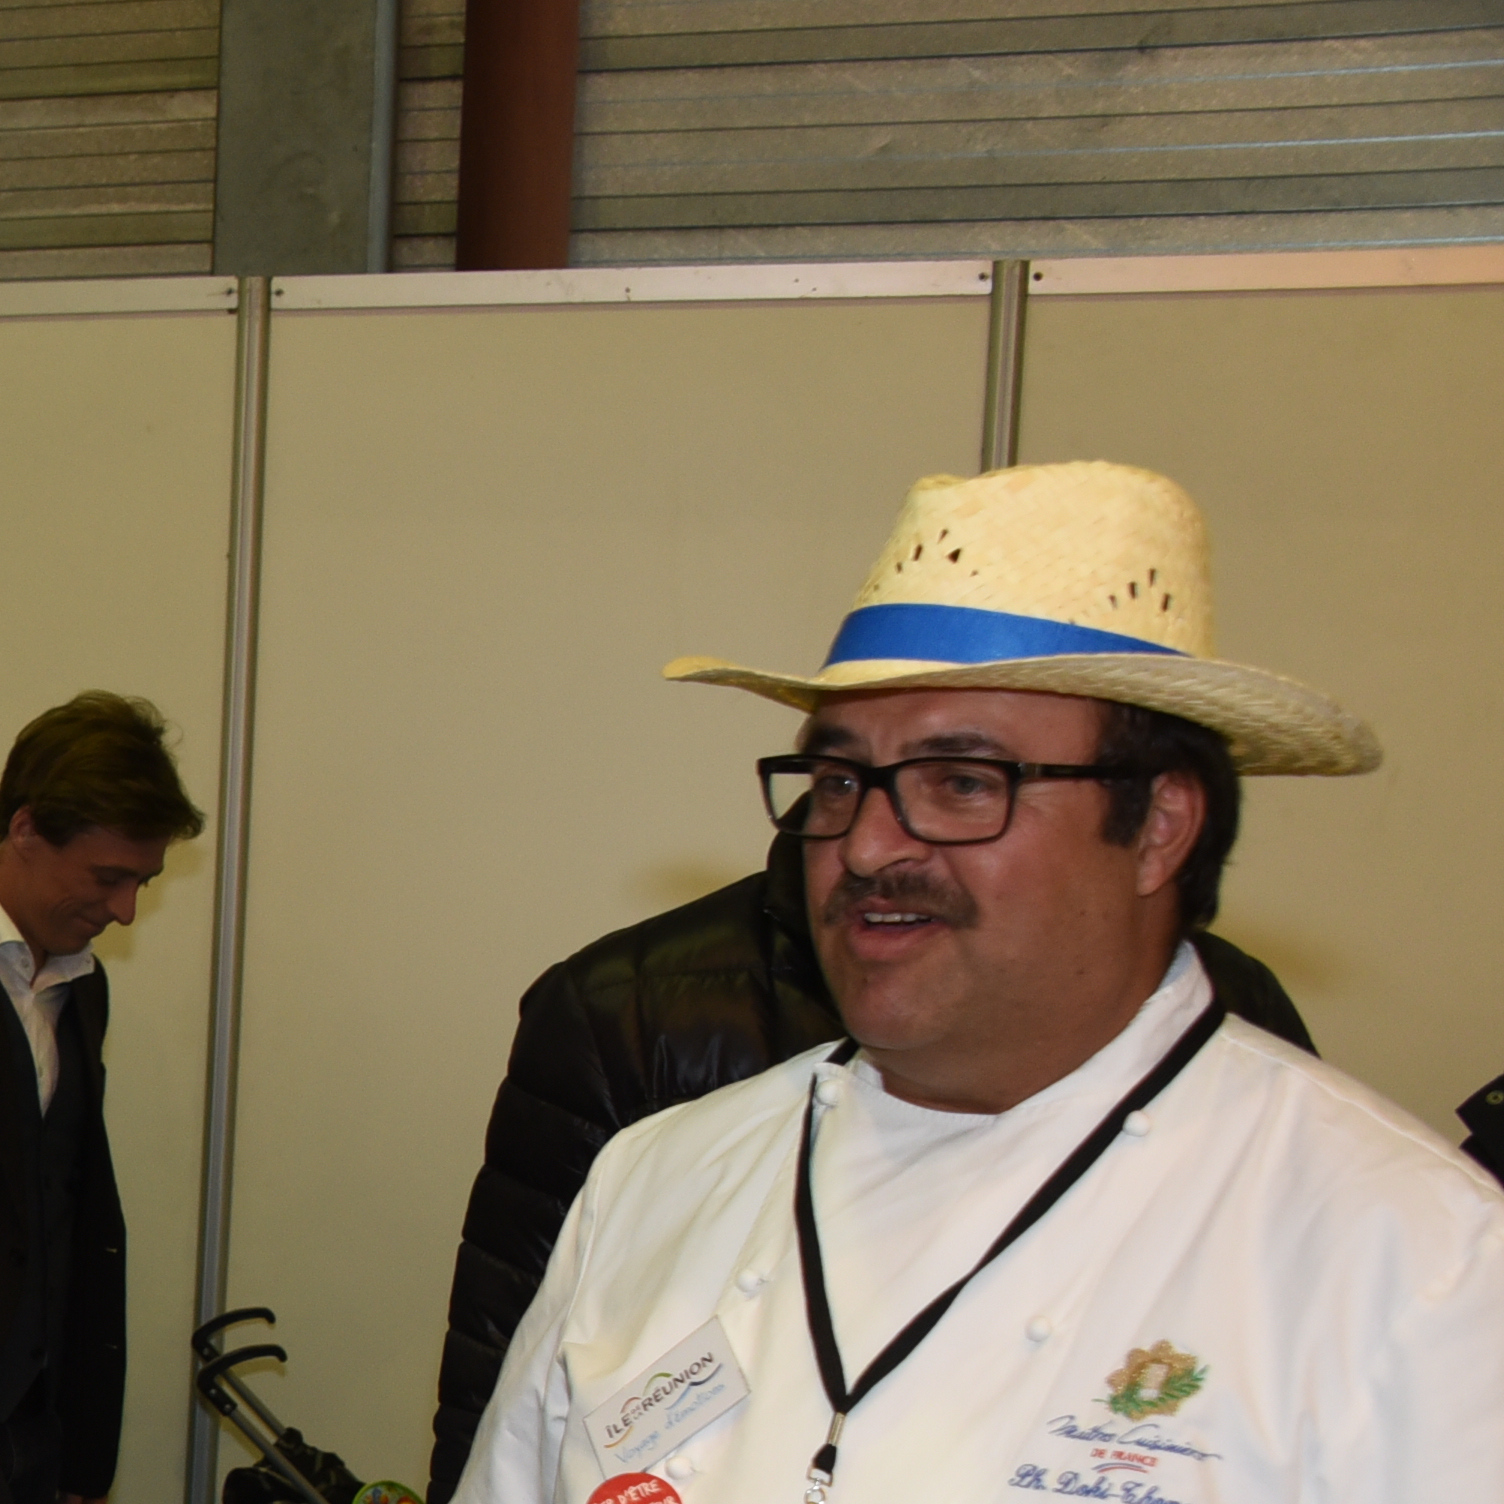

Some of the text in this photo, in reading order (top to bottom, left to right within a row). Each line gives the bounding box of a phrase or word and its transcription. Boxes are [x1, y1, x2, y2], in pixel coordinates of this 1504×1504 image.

[641, 1352, 715, 1412] RÉUNION
[1090, 1448, 1159, 1467] DE FRANCE
